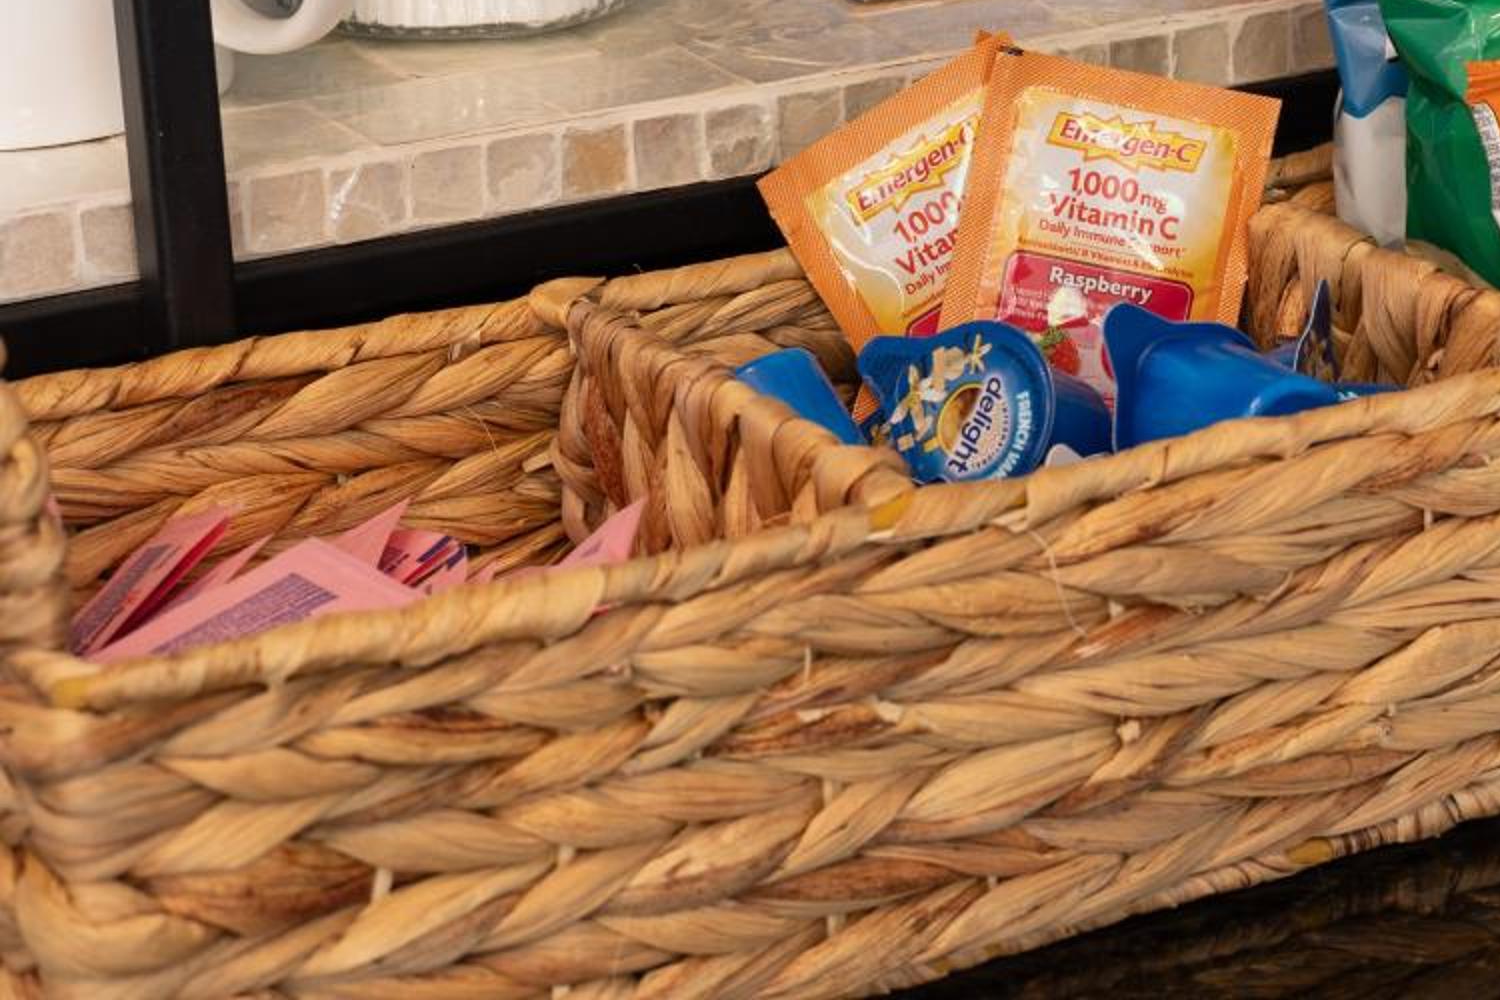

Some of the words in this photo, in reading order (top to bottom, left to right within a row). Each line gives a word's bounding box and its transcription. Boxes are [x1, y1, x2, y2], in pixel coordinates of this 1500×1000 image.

[1039, 218, 1071, 238] Daily
[1050, 192, 1155, 237] Vitamin
[1159, 216, 1180, 241] C
[1048, 265, 1153, 305] Raspberry
[947, 377, 1002, 473] delight
[1012, 389, 1032, 452] FRENCH
